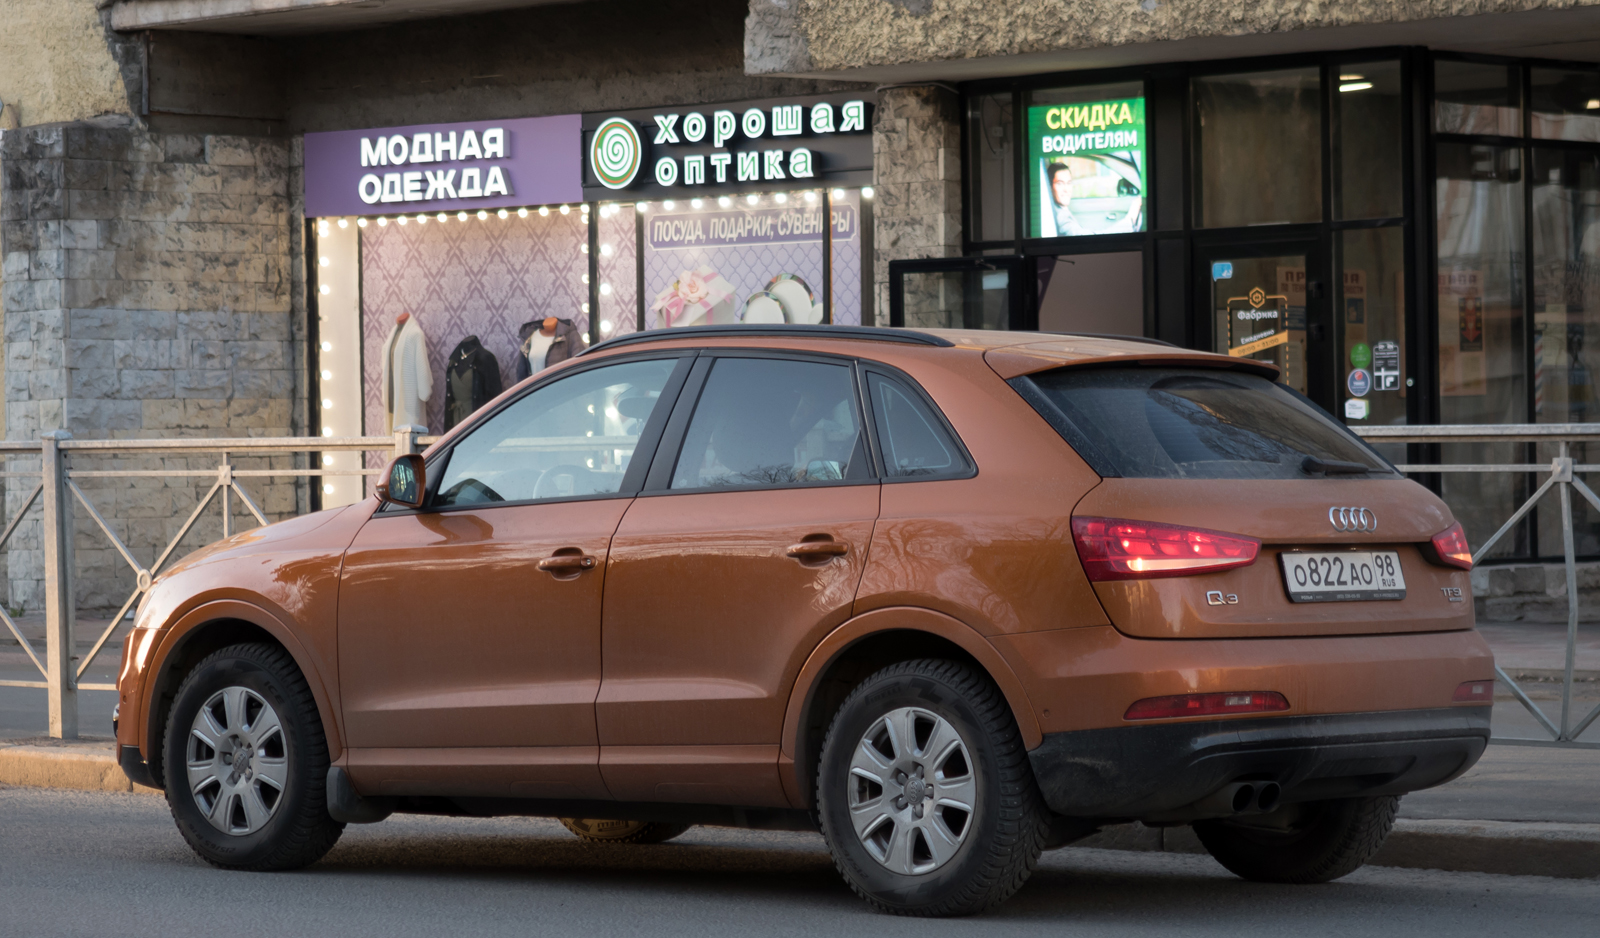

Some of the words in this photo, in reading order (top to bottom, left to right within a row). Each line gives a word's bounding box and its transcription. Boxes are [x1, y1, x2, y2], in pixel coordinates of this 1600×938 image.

[653, 100, 865, 148] хорошая
[1045, 102, 1133, 131] СКИДКА
[360, 127, 505, 167] МОДНАЯ
[1042, 130, 1138, 154] ВОДИТЕЛЯМ
[655, 148, 814, 187] оптика
[358, 165, 508, 205] ОДЕЖДА
[653, 218, 706, 244] ПОСУДА,
[709, 215, 774, 243] ПОДАРКИ,
[777, 211, 850, 236] СУВЕНРЫ
[1237, 308, 1279, 321] Фабрика
[1240, 328, 1275, 344] Ежедневно
[1374, 554, 1395, 577] 98
[1382, 578, 1396, 587] RUS
[1440, 587, 1462, 597] TFSI
[1206, 590, 1239, 606] Q3
